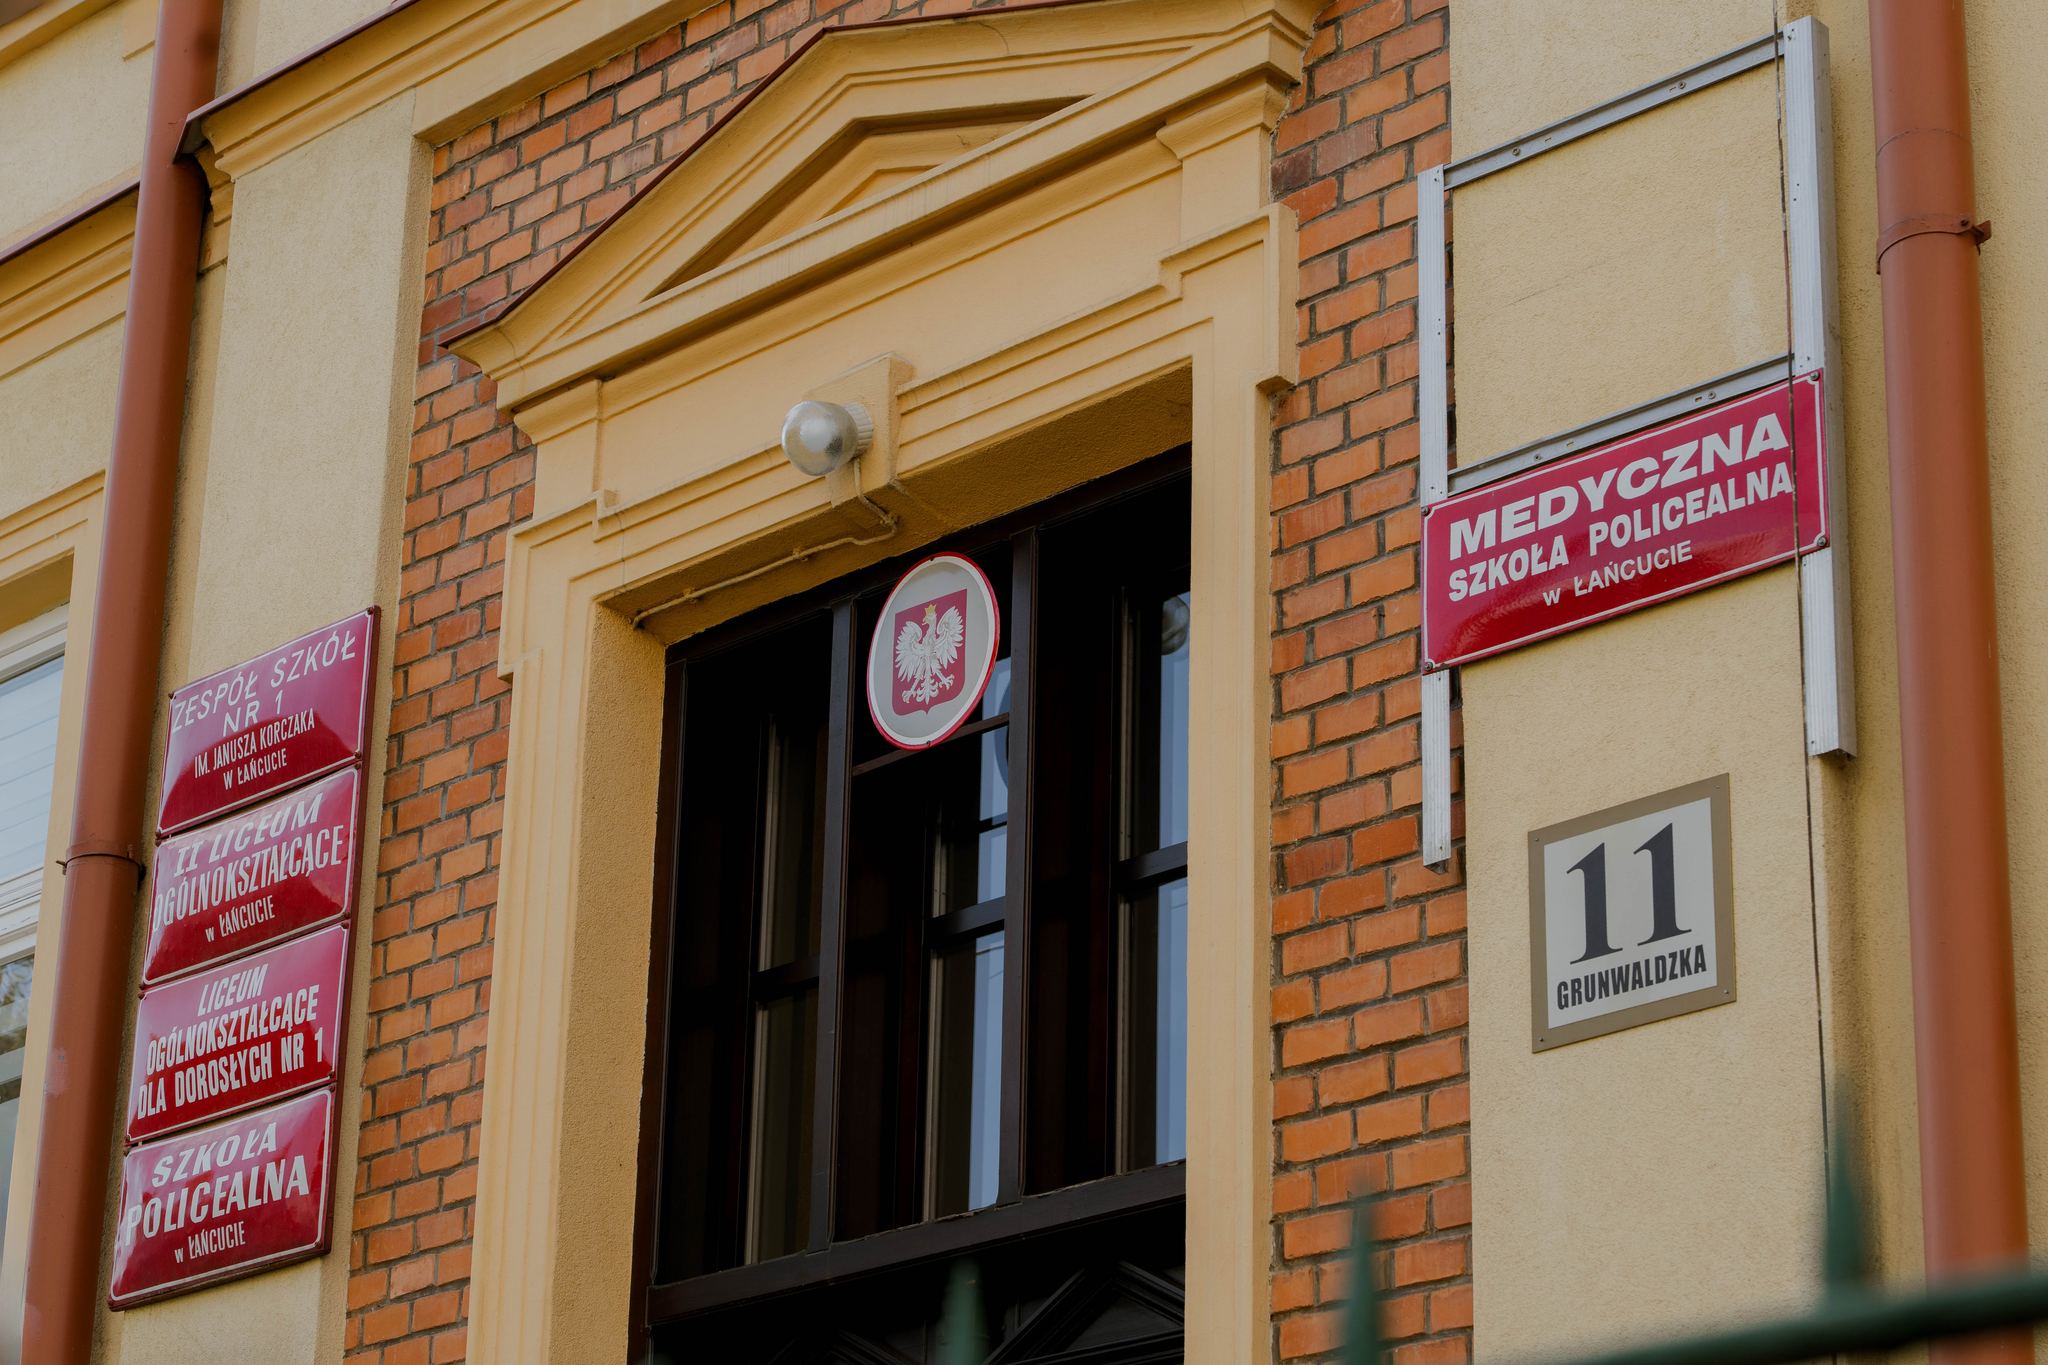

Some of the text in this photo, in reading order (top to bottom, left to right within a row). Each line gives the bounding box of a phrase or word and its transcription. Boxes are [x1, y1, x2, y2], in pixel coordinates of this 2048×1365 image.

[1449, 412, 1789, 561] MEDYCZNA
[1448, 461, 1794, 602] SZKOŁA POLICEALNA
[1574, 540, 1693, 598] ŁAŃCUCIE
[172, 630, 356, 733] ZESPÓŁ SZKÓŁ
[222, 690, 283, 737] NR 1
[194, 707, 315, 778] IM. JANUSZA KORCZAKA
[237, 748, 287, 784] ŁAŃCUCIE
[174, 792, 323, 877] II LICEUM
[152, 824, 344, 932] OGÓLNOKSZTAŁCĄCE
[219, 895, 275, 937] ŁAŃCUCIE
[1566, 822, 1692, 965] 11
[198, 963, 268, 1016] LICEUM
[1557, 944, 1707, 1010] GRUNWALDZKA
[146, 984, 319, 1075] OGÓLNOKSZTAŁCĄCE
[137, 1027, 323, 1119] DLA DOROSŁYCH NR 1
[152, 1122, 277, 1188] SZKOŁA
[125, 1155, 309, 1246] POLICEALNA
[188, 1221, 246, 1259] ŁAŃCUCIE
